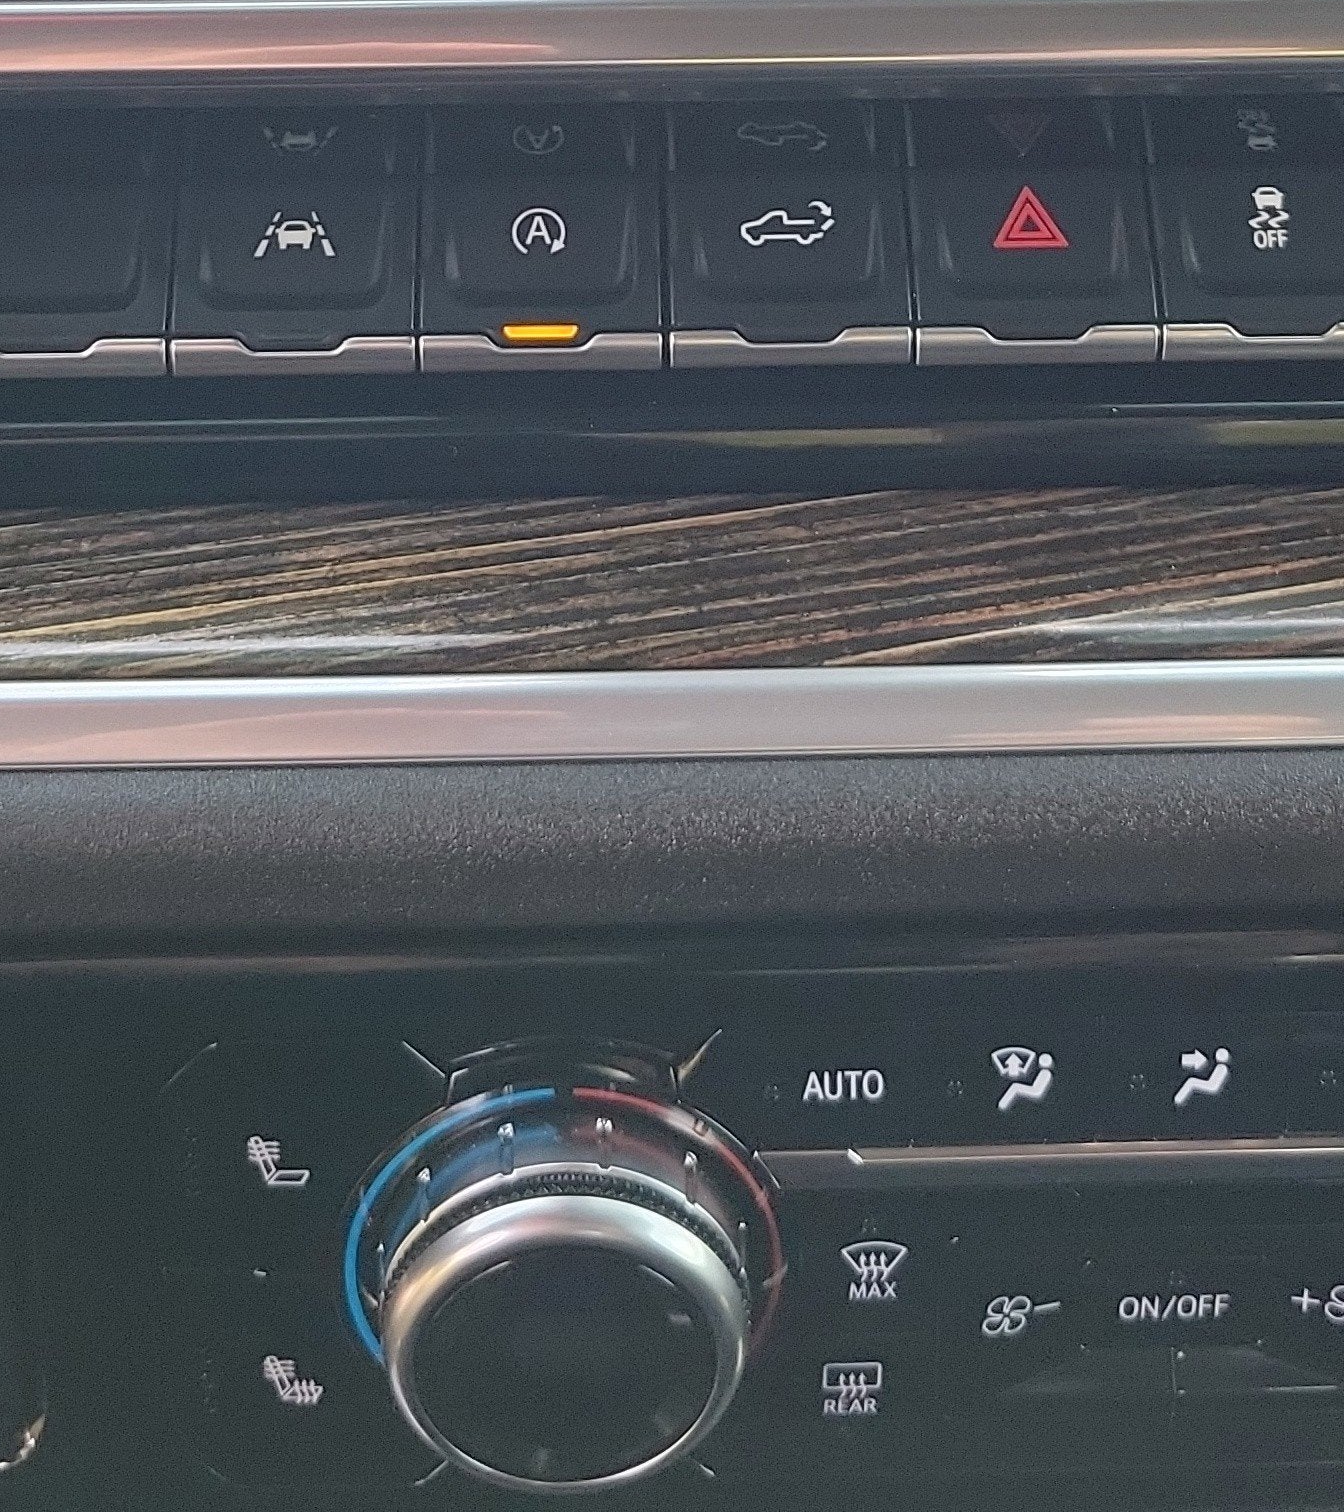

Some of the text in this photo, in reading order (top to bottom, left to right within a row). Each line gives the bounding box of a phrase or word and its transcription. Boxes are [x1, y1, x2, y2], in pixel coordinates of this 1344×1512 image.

[1253, 229, 1289, 249] OFF
[803, 1069, 884, 1101] AUTO
[849, 1278, 897, 1299] MAX
[1118, 1293, 1230, 1321] ON/OFF
[823, 1397, 878, 1414] REAR
